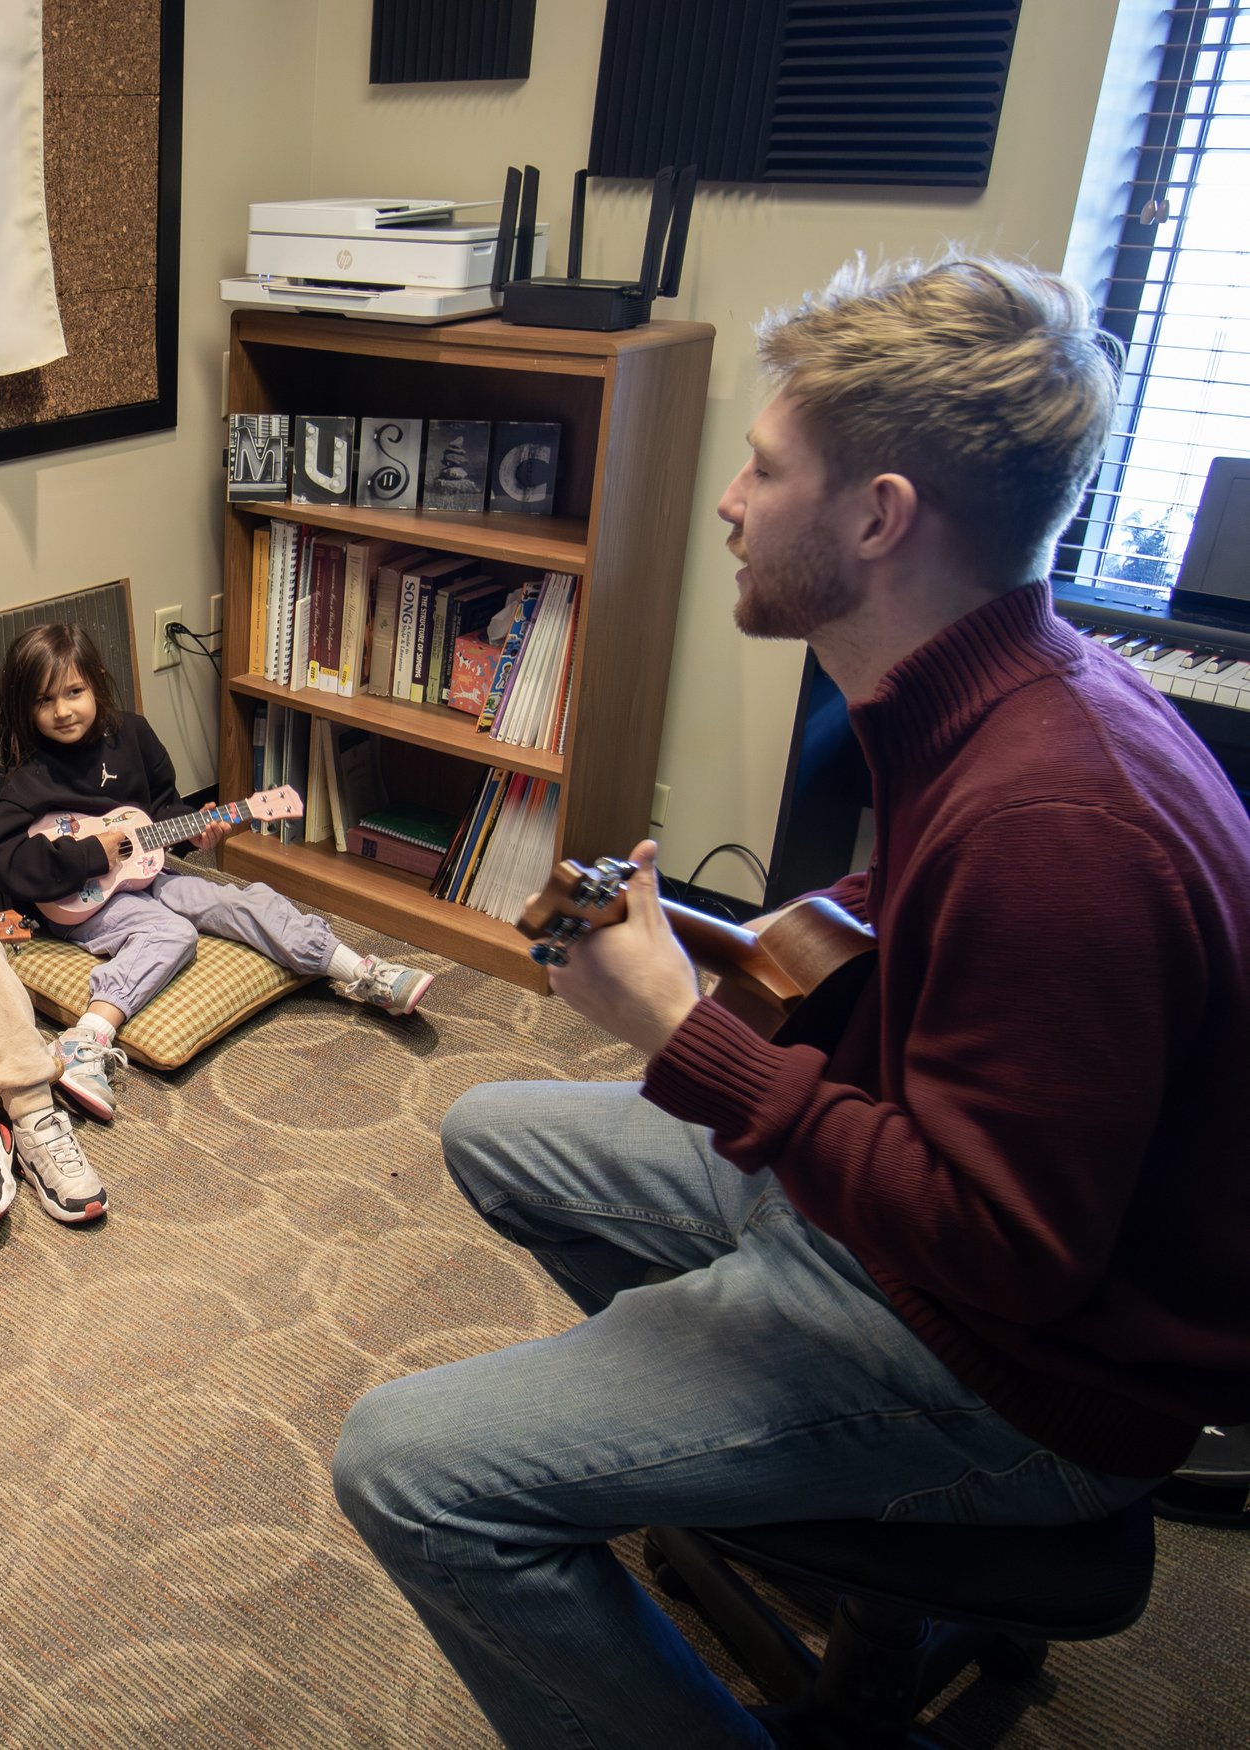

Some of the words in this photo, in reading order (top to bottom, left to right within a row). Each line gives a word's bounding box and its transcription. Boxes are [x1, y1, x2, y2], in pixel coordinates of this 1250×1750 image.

[337, 249, 352, 270] hp
[401, 580, 416, 625] SONG
[420, 595, 428, 607] THE
[417, 608, 427, 642] STRUCTURE
[416, 643, 424, 652] OF
[322, 668, 338, 677] USED
[414, 653, 423, 678] SINGING
